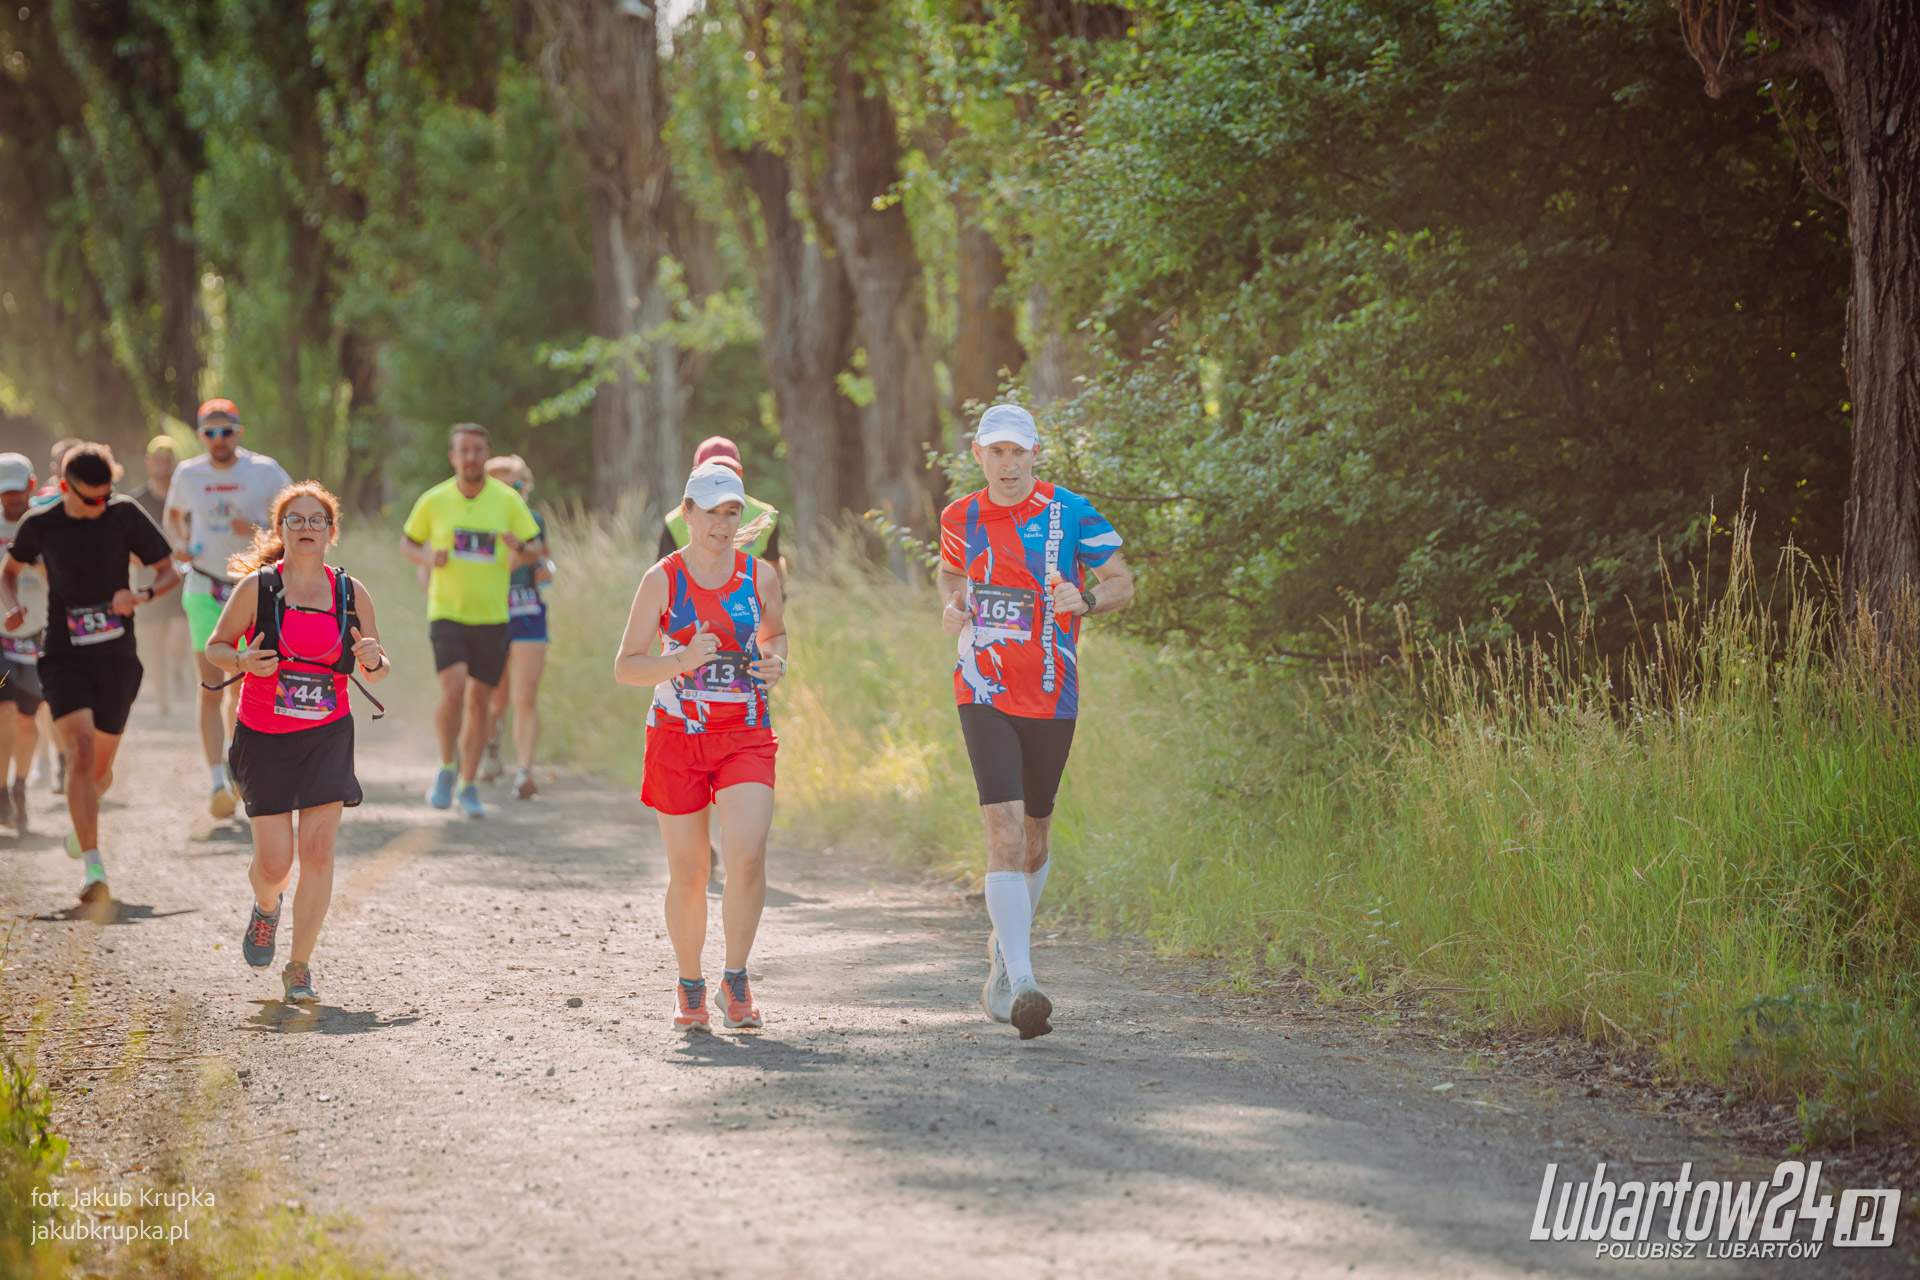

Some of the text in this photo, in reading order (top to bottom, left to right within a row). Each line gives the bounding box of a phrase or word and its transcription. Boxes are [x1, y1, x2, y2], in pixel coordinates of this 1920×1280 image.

[980, 598, 1021, 621] 165
[83, 612, 107, 632] 53
[706, 663, 736, 684] 13
[294, 684, 323, 704] 44
